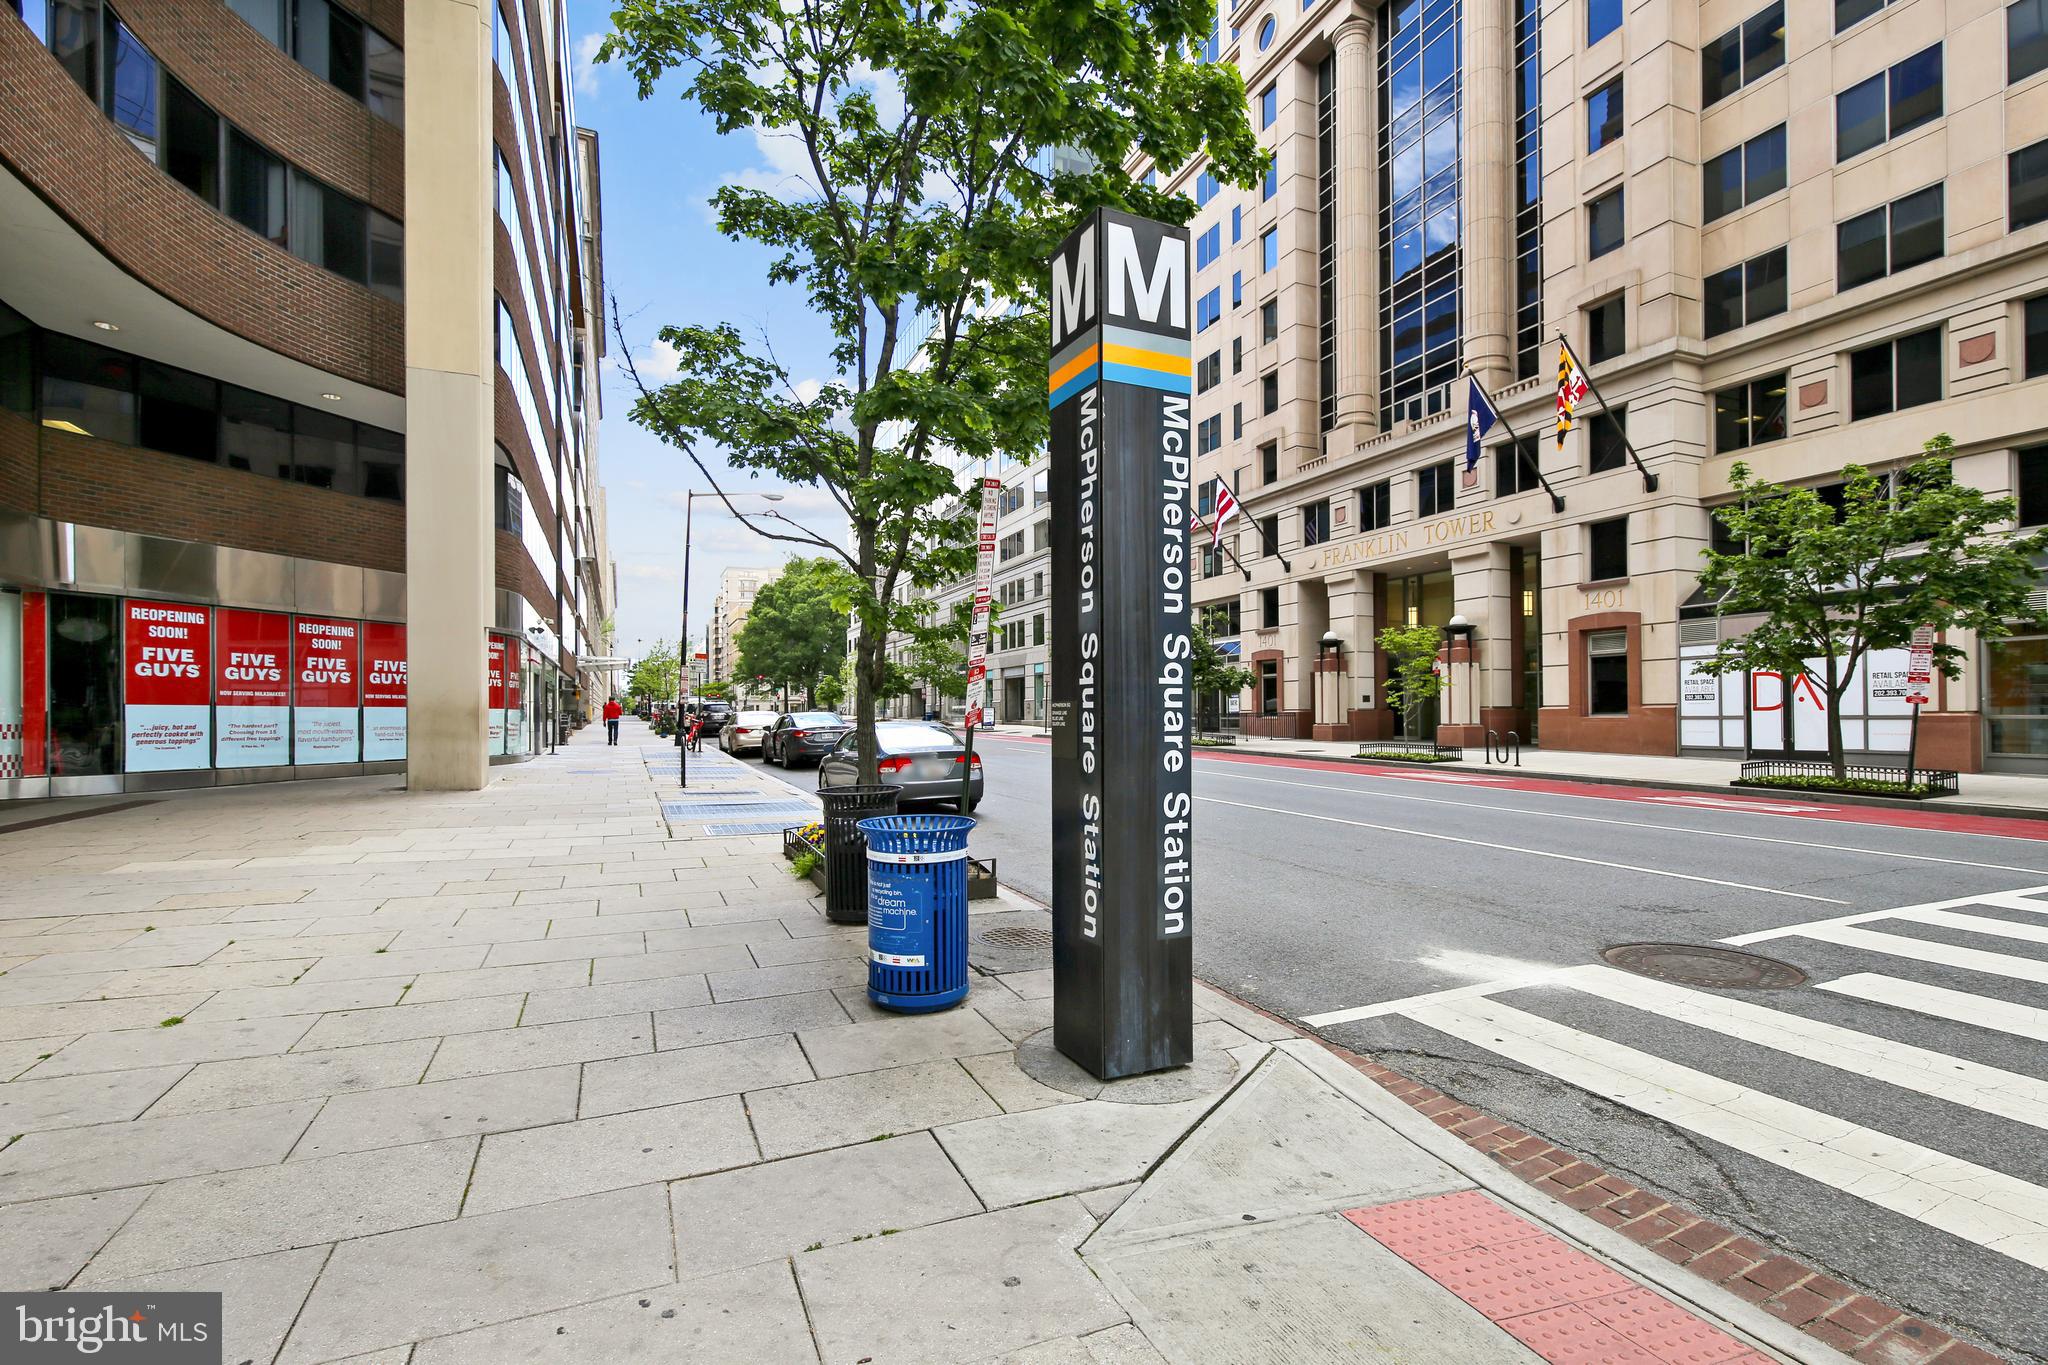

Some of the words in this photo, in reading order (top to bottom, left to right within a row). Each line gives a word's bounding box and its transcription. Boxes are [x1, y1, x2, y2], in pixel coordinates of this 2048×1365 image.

[1107, 221, 1186, 329] M
[1052, 223, 1095, 347] M
[1080, 386, 1098, 614] McPherson
[1162, 395, 1190, 614] McPherson
[1323, 531, 1408, 567] FRANKLIN
[1424, 510, 1496, 545] TOWER
[1585, 589, 1624, 610] 1401
[131, 607, 205, 625] REOPENING
[148, 625, 188, 640] SOON!
[299, 623, 354, 637] REOPENING
[312, 638, 342, 650] SOON!
[142, 646, 195, 663] FIVE
[231, 652, 276, 667] FIVE
[134, 662, 201, 678] GUYS
[307, 656, 347, 670] FIVE
[374, 660, 407, 673] FIVE
[224, 666, 281, 682] GUYS
[302, 670, 351, 684] GUYS
[1874, 689, 1906, 697] 202.393.70
[1078, 632, 1099, 774] Square
[1158, 633, 1191, 773] Square
[1082, 793, 1101, 939] Station
[1163, 791, 1190, 935] Station
[877, 896, 906, 907] dream
[882, 908, 918, 916] machine.
